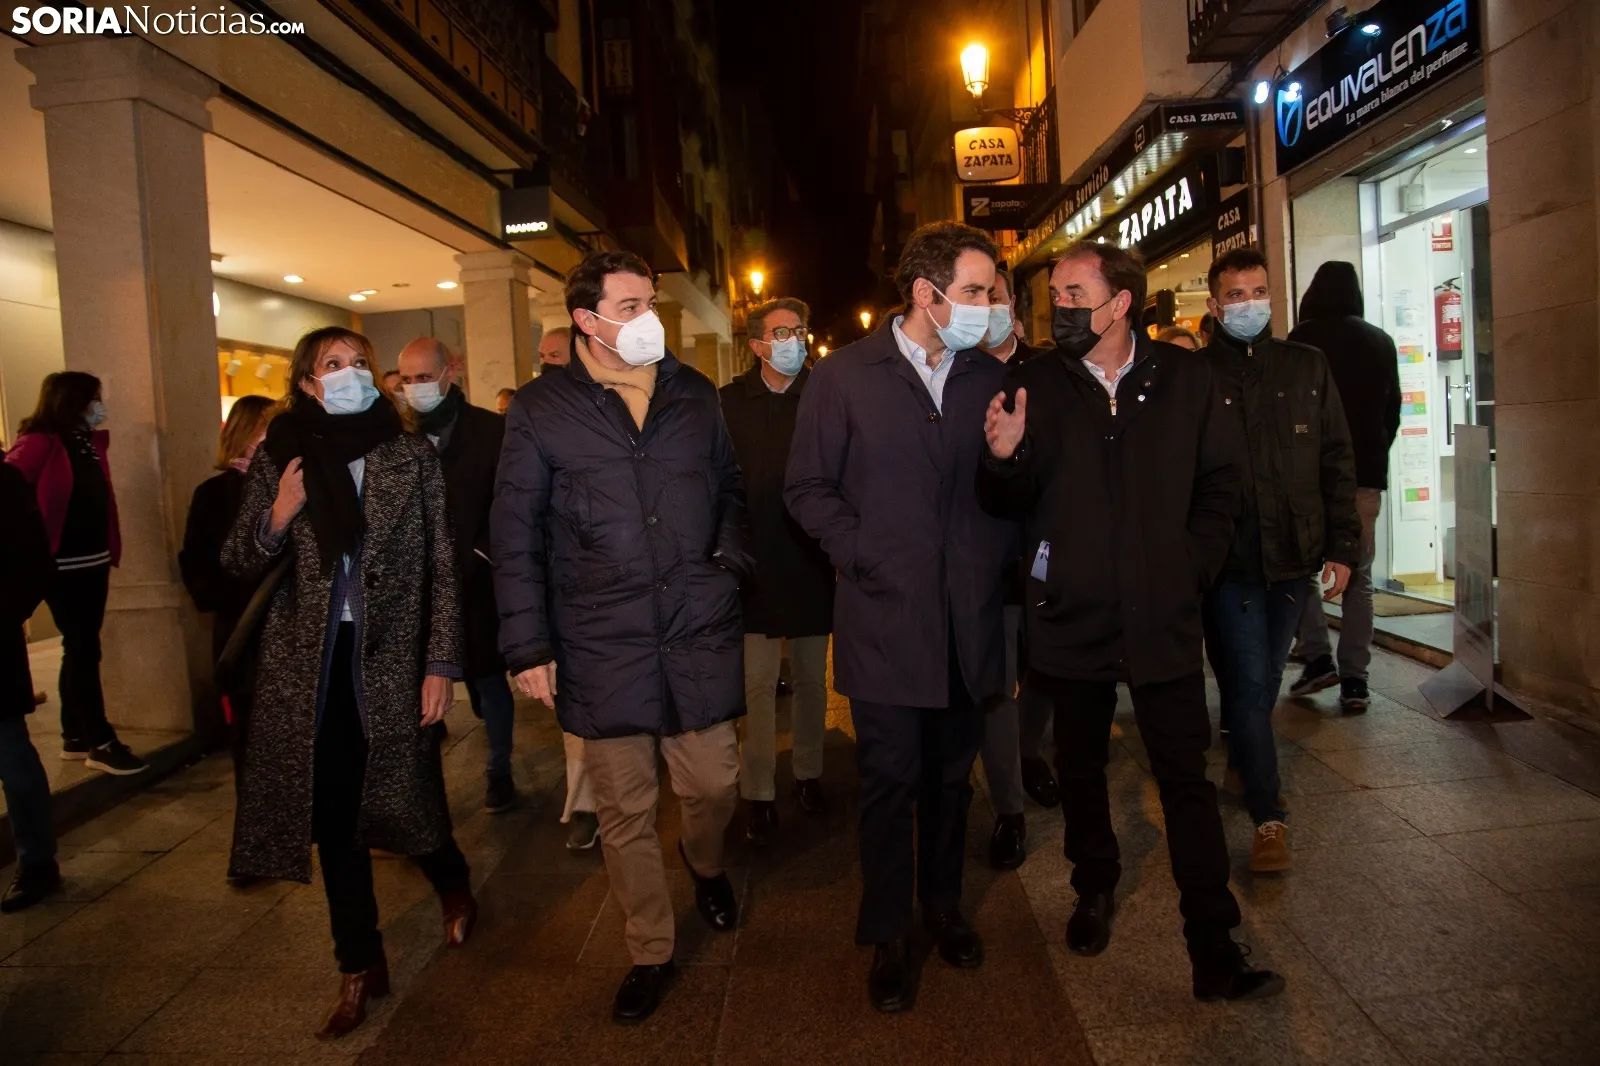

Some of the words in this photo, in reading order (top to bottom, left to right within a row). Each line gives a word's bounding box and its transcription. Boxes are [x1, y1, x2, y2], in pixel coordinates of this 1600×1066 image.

[1356, 97, 1380, 119] marca
[1380, 79, 1410, 103] blanca
[1410, 65, 1425, 85] del
[1426, 41, 1468, 79] perfume
[1169, 114, 1197, 124] CASA
[1200, 111, 1238, 122] ZAPATA
[969, 138, 1005, 150] CASA
[964, 153, 1014, 168] ZAPATA
[1118, 176, 1193, 251] ZAPATA
[1217, 206, 1241, 231] CASA
[1215, 231, 1247, 258] ZAPATA
